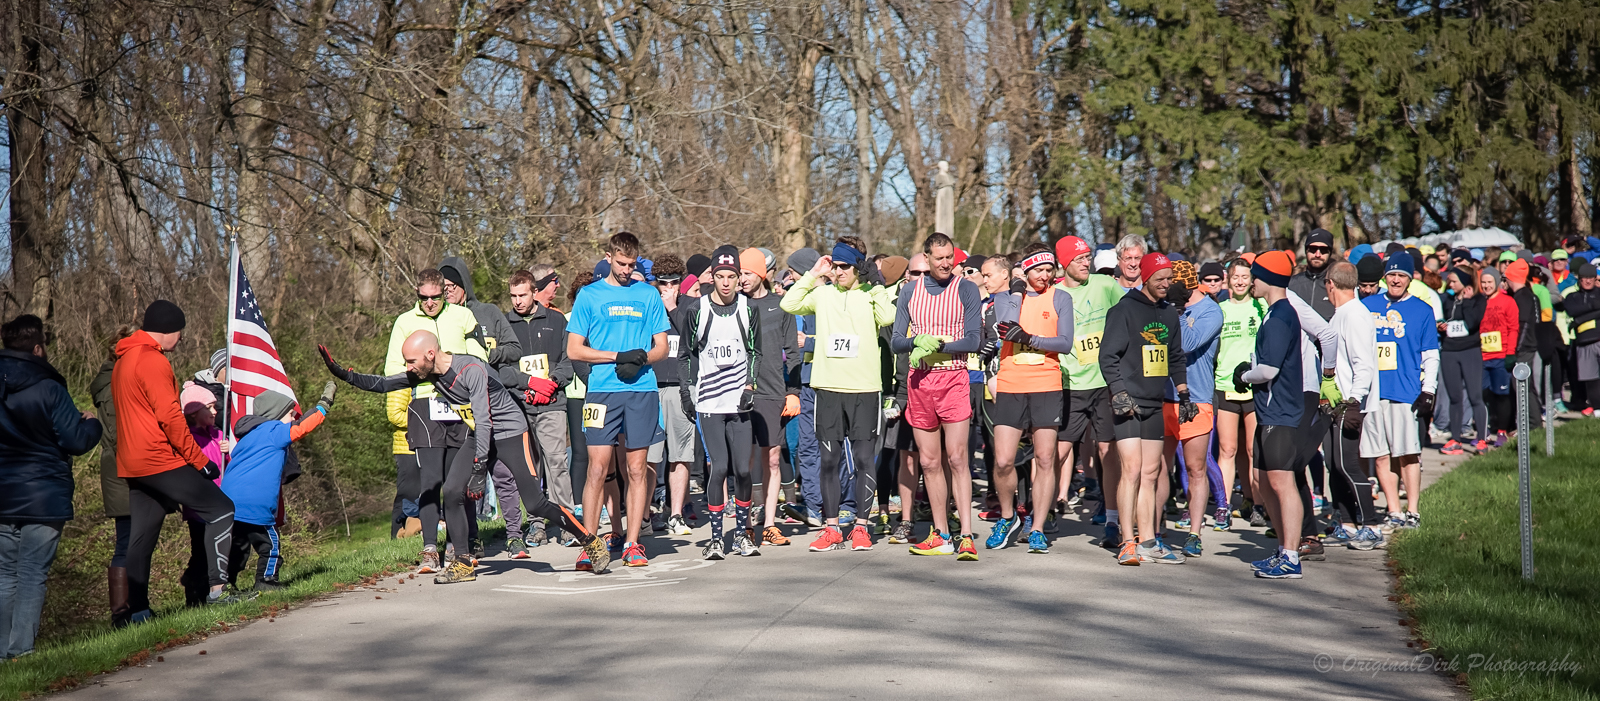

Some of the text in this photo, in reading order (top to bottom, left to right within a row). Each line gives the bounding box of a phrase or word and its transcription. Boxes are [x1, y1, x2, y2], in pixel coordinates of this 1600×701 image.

[834, 339, 850, 351] 574
[1081, 336, 1100, 351] 163
[1484, 336, 1497, 344] 159
[714, 345, 731, 358] 706
[1149, 350, 1164, 362] 179
[1377, 346, 1391, 357] 78
[525, 359, 544, 372] 241
[584, 408, 599, 420] 230
